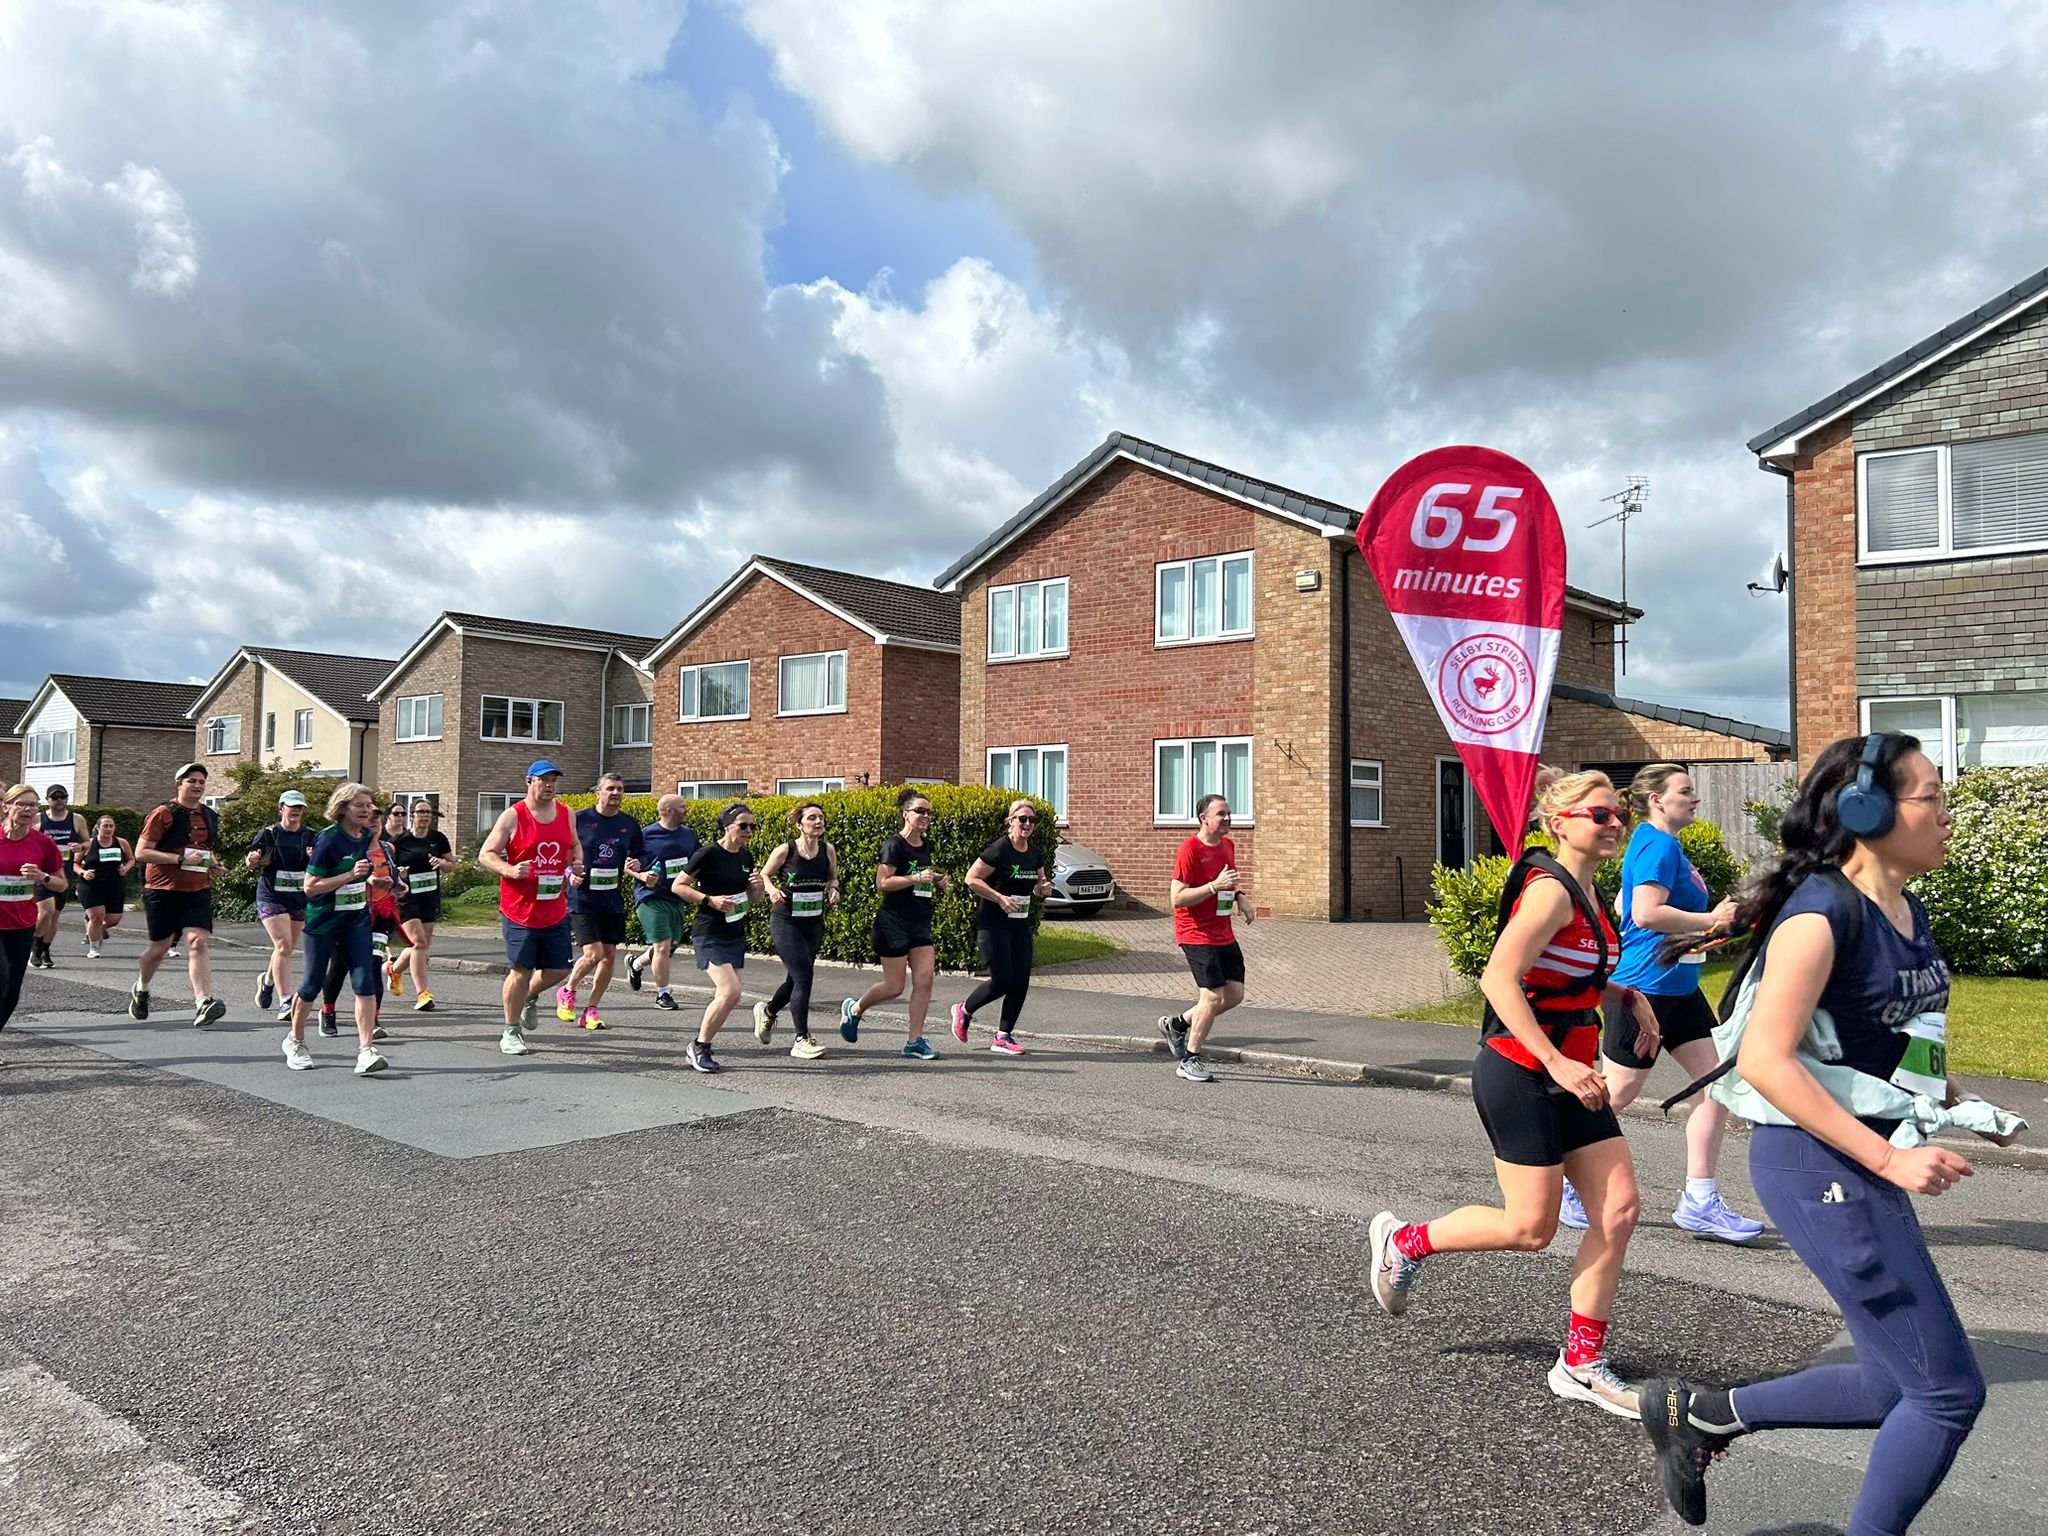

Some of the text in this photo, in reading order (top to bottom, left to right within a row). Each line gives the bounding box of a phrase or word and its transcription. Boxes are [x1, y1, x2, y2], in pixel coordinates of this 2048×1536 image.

[1410, 482, 1524, 553] 65
[1393, 566, 1523, 599] minutes
[1450, 642, 1529, 684] SELBY STRIDERS
[1451, 698, 1521, 727] RUNNING CLUB
